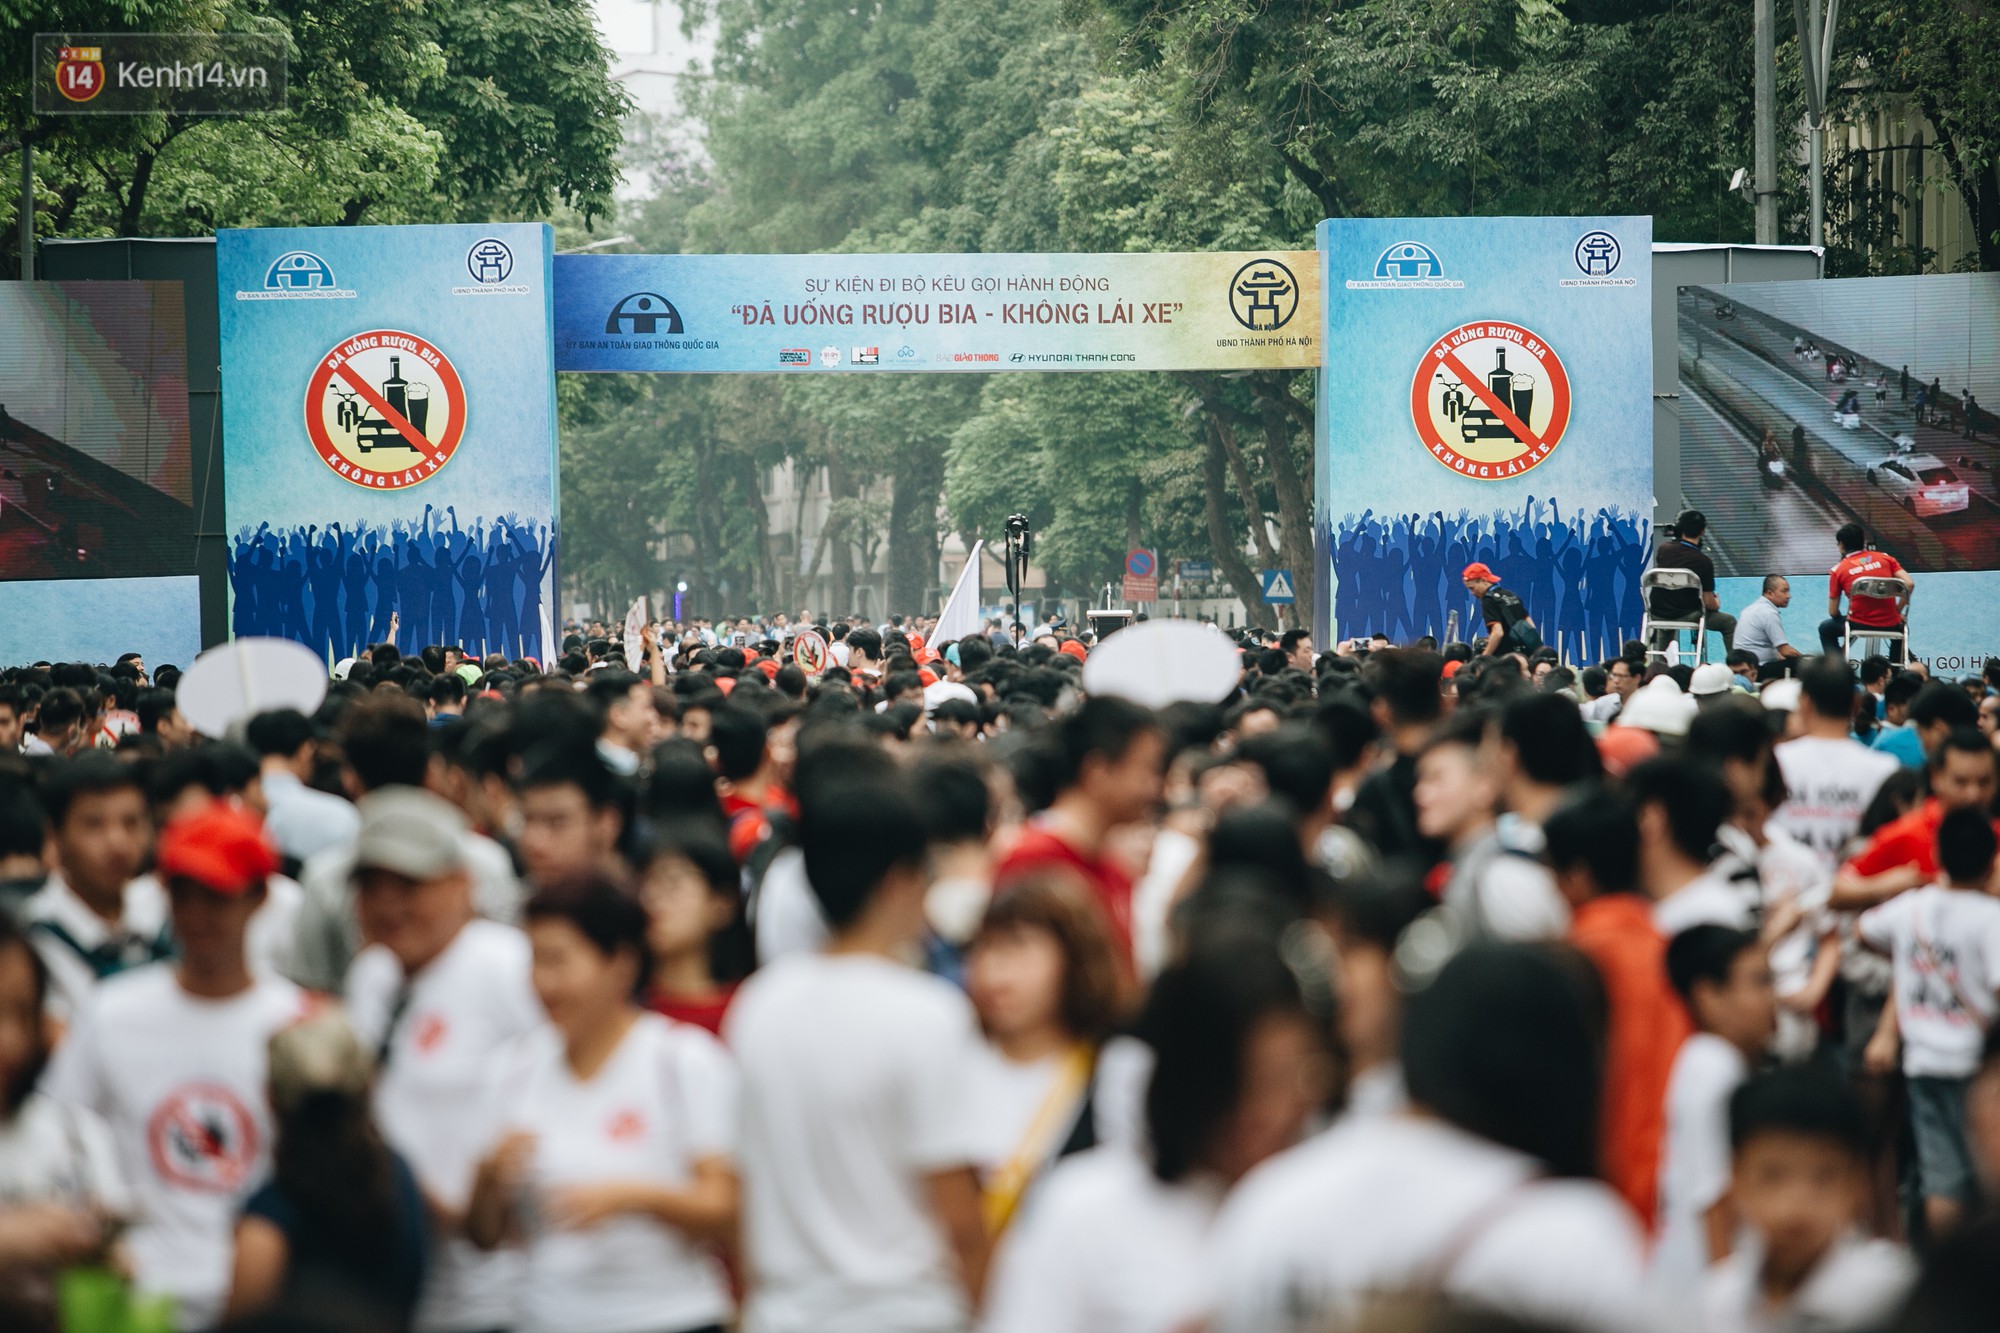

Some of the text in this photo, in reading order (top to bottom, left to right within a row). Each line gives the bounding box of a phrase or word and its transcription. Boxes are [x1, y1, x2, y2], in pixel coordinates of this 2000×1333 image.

[805, 274, 1109, 295] SỰ KIỆN ĐI BỘ KÊU GỌI HÀNH ĐỘNG
[784, 297, 853, 325] UỐNG
[863, 301, 929, 329] RƯỢU
[939, 303, 977, 324] BIA
[1003, 299, 1089, 324] KHÔNG
[1098, 297, 1133, 324] LÁI
[327, 352, 346, 370] ĐÃ
[344, 336, 378, 355] UỐNG
[419, 347, 441, 368] BIA
[579, 340, 595, 349] BAN
[597, 340, 608, 349] AN
[611, 339, 631, 349] TOÀN
[633, 340, 652, 349] GIAO
[654, 339, 681, 349] THÔNG
[682, 338, 703, 350] QUỐC
[705, 340, 720, 349] GIA
[1216, 335, 1312, 347] UBND THÀNH PHỐ HÀ NỘI
[1433, 341, 1452, 359] ĐÃ
[1450, 326, 1485, 346] UỐNG
[1525, 338, 1547, 359] BIA
[1028, 354, 1136, 362] HYUNDAI THANH CONG
[327, 451, 447, 487] KHÔNG LÁI XE
[1432, 443, 1550, 477] KHÔNG LÁI XE
[1936, 656, 1965, 672] GỌI
